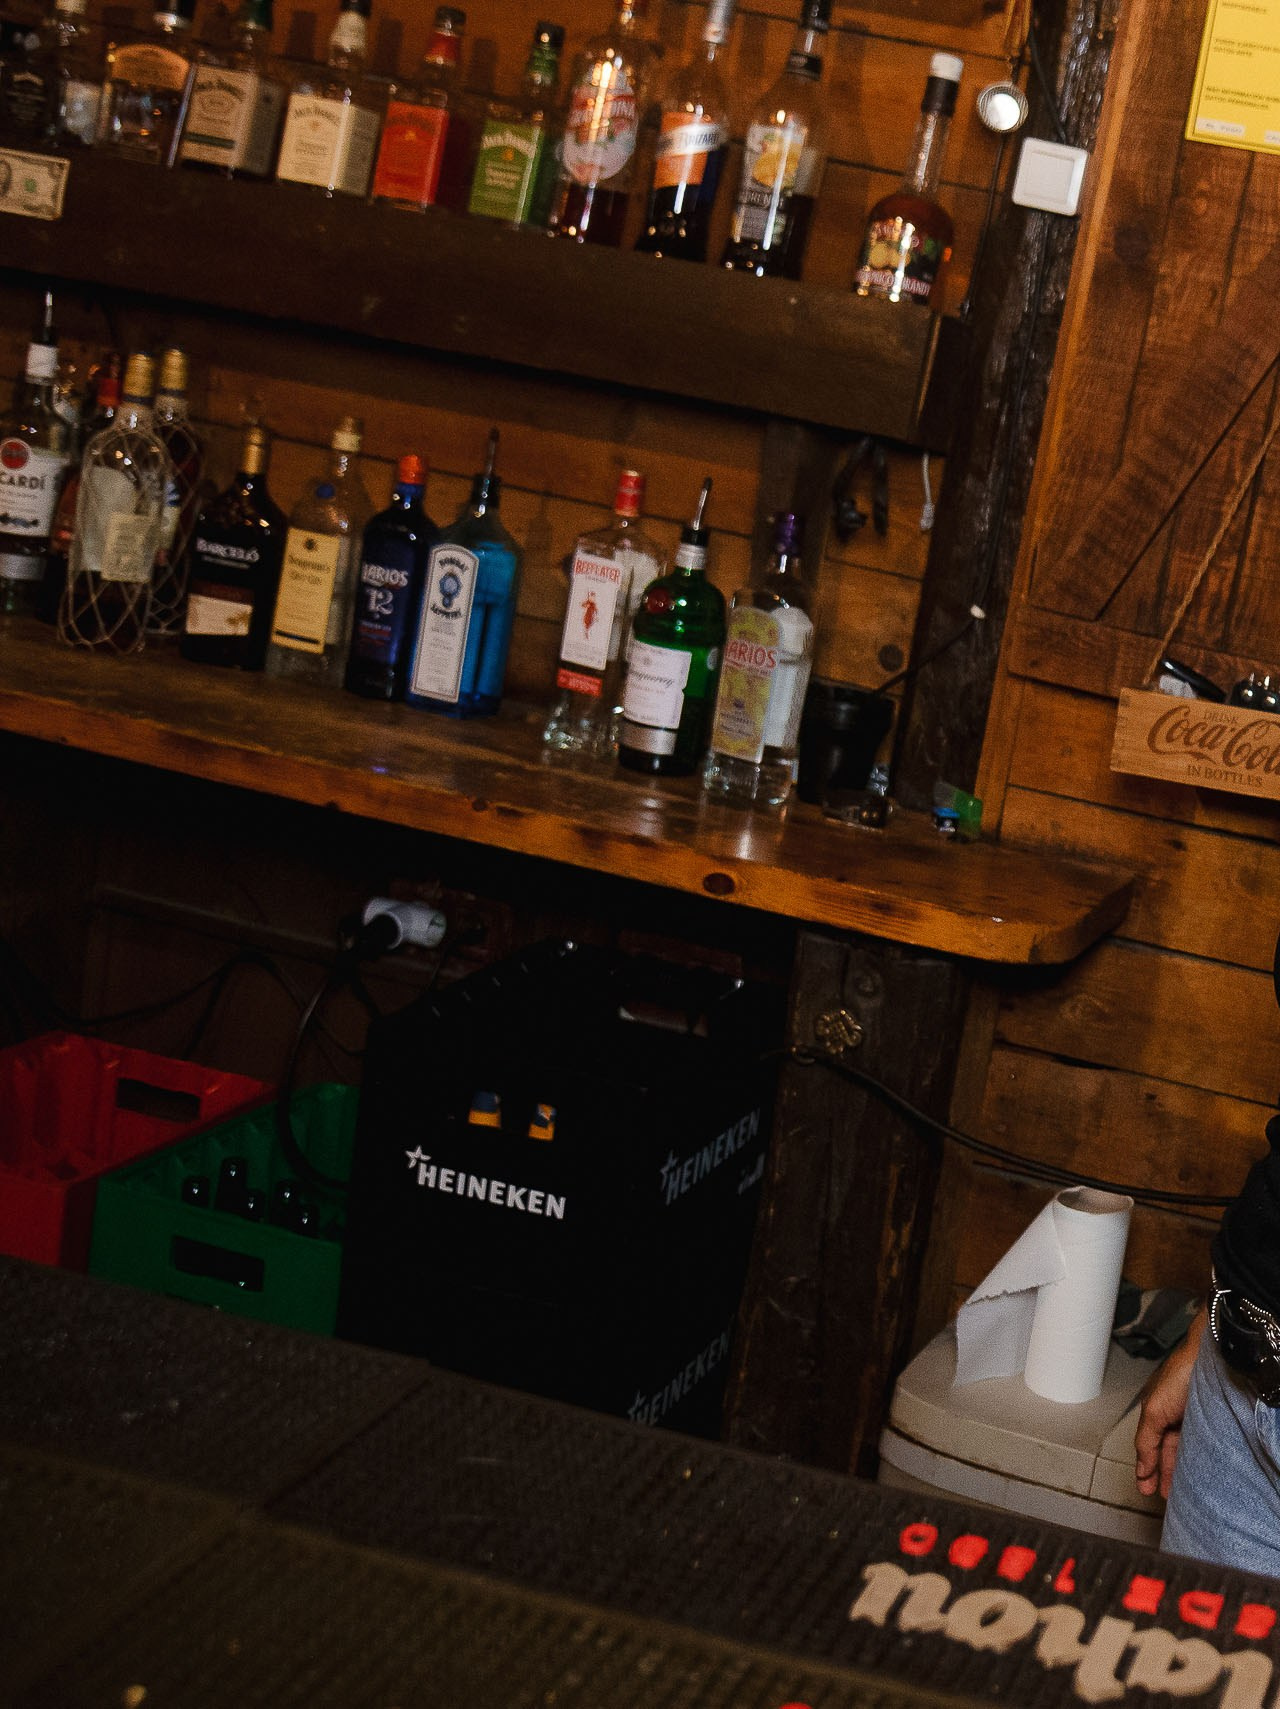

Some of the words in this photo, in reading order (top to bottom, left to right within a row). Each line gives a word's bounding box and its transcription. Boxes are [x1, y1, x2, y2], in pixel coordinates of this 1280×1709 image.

[575, 558, 621, 583] BEEFEATER
[1203, 710, 1238, 724] DRINK
[1187, 765, 1201, 778] IN
[1203, 767, 1262, 788] BOTTLES
[664, 1106, 761, 1207] HEINEKEN
[416, 1160, 567, 1220] HEINEKEN
